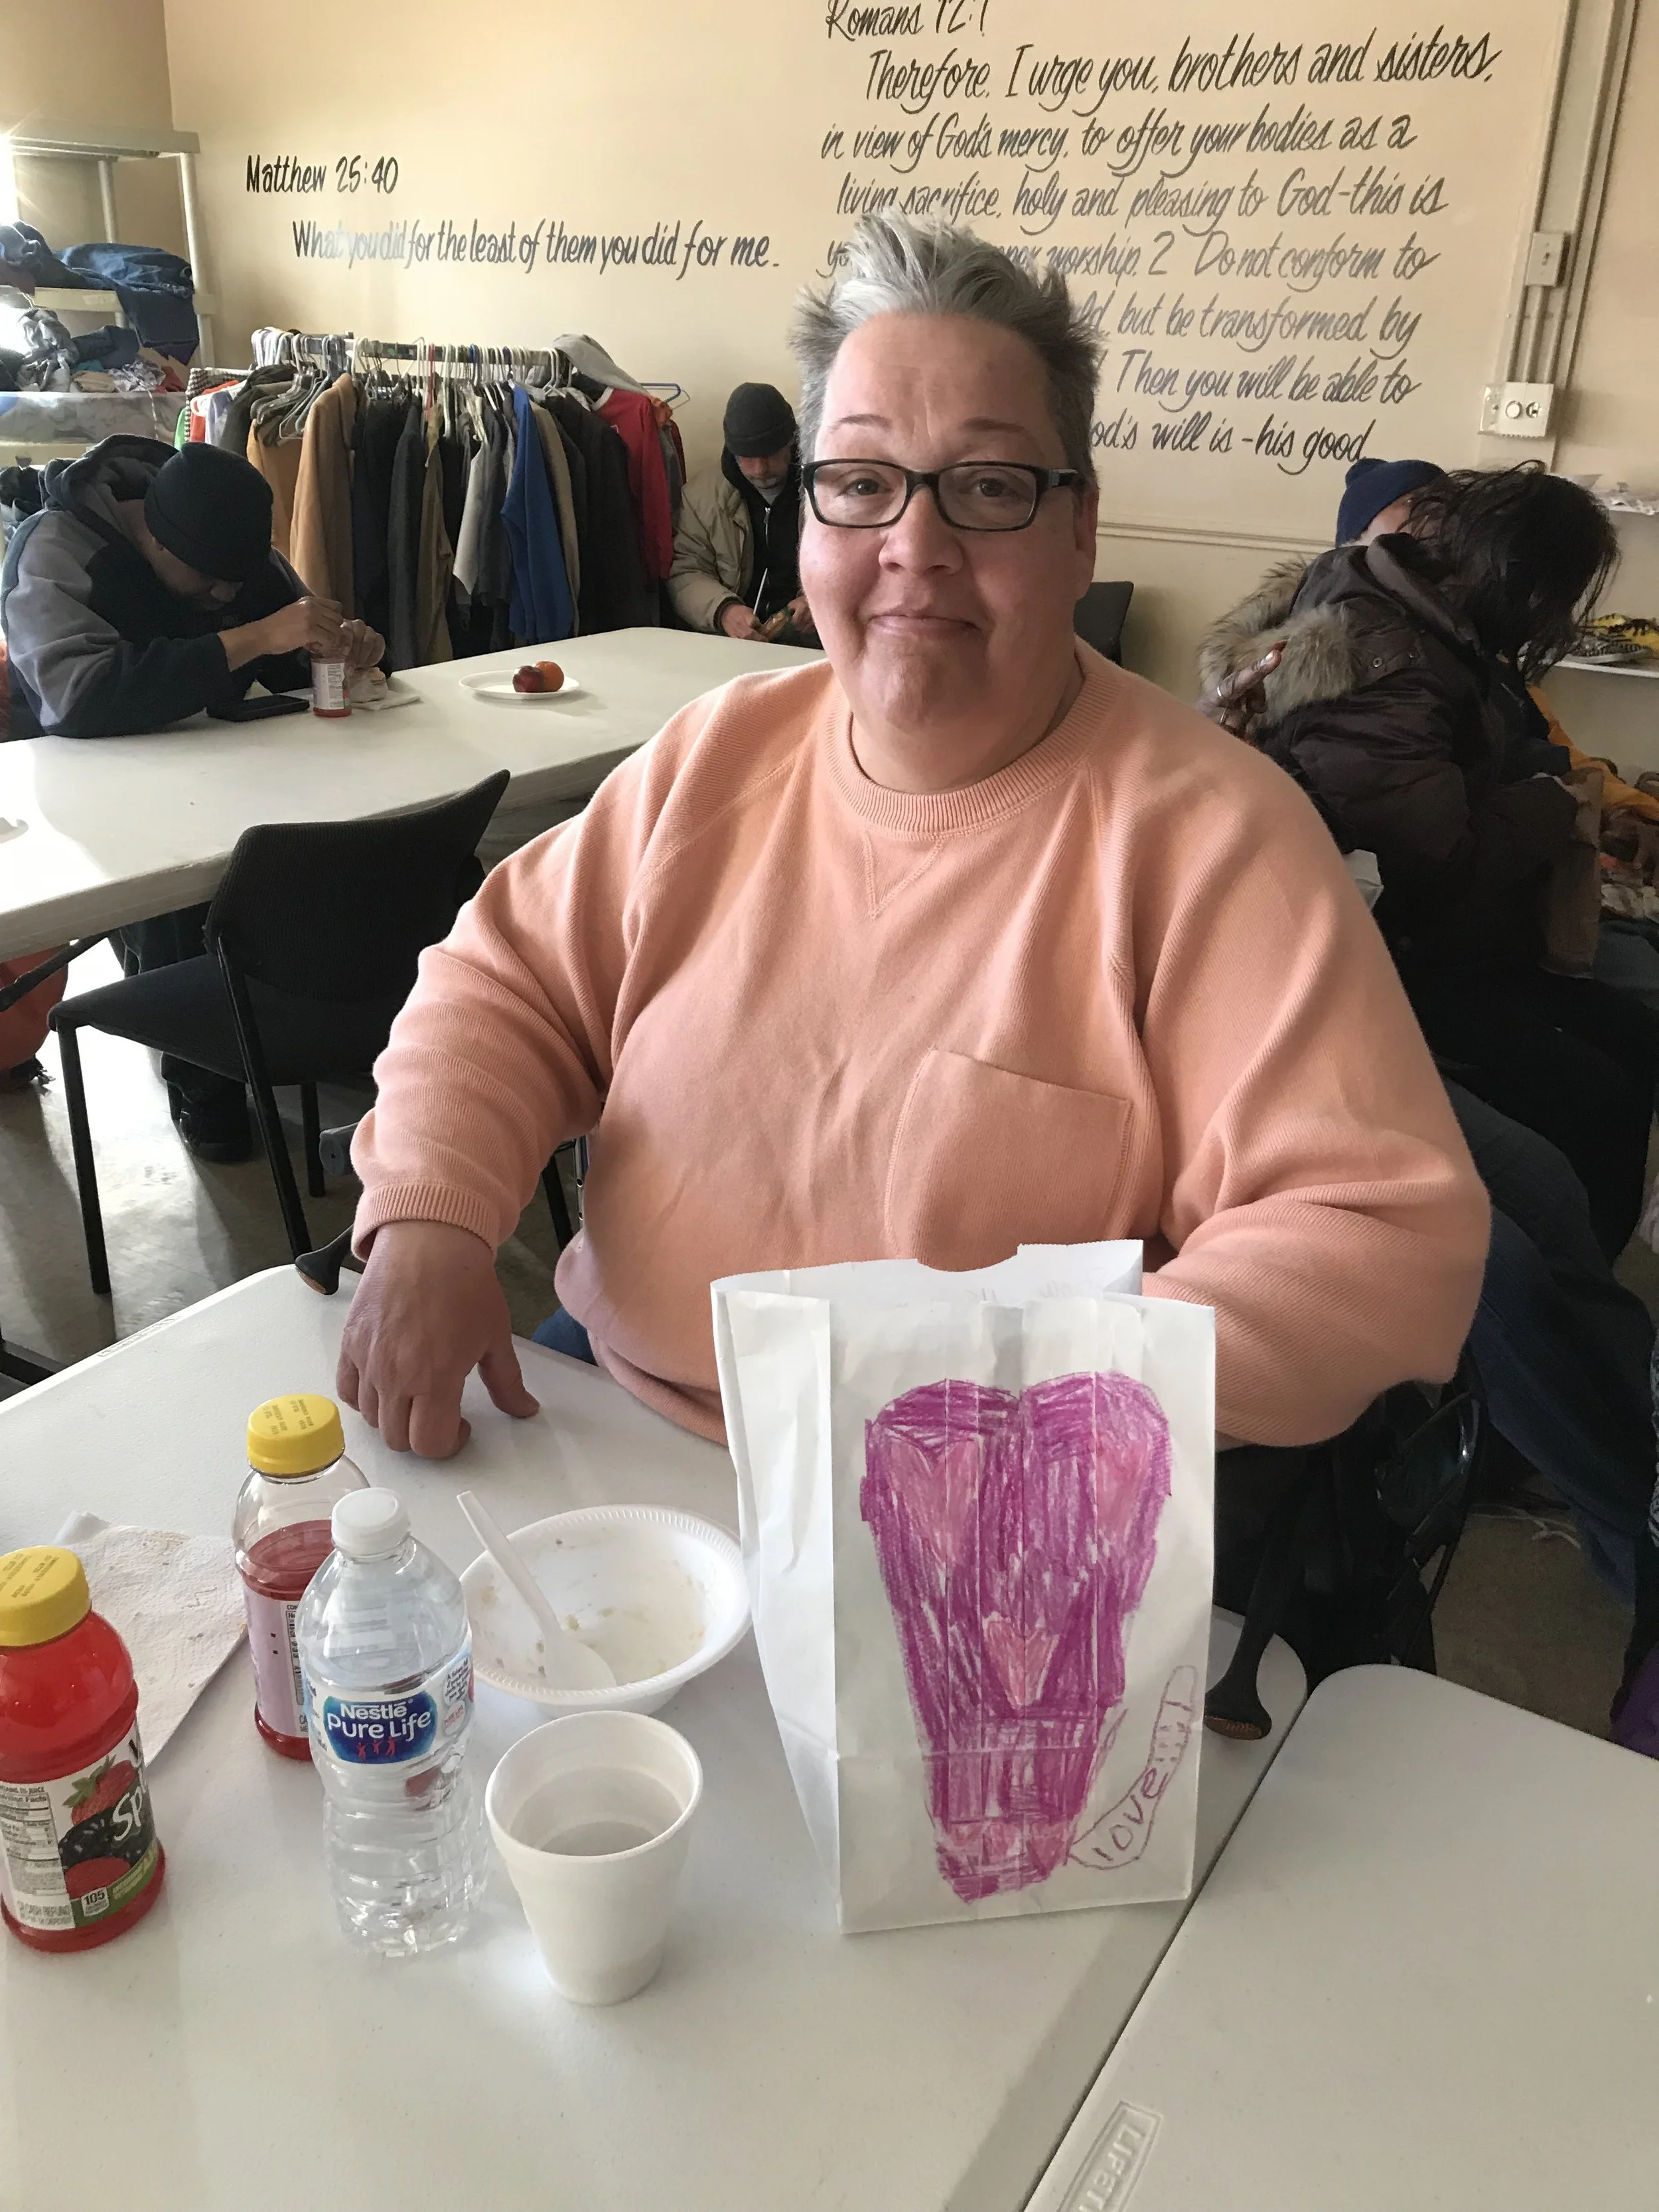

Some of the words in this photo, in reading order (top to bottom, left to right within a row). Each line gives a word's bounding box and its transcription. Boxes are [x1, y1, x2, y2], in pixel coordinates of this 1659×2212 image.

[826, 0, 924, 42] Romans
[1005, 43, 1034, 98] I
[1028, 54, 1094, 112] urge
[1168, 32, 1303, 92] brothers
[1307, 27, 1377, 84] and
[821, 123, 845, 159] in
[853, 124, 906, 159] view
[890, 112, 940, 174] of
[936, 112, 993, 159] God's
[1082, 117, 1115, 156] to
[1106, 108, 1185, 178] offer
[1159, 121, 1251, 179] your
[1246, 102, 1334, 153] bodies
[1338, 114, 1384, 151] as
[1387, 113, 1418, 149] a
[246, 154, 327, 193] Matthew
[335, 155, 399, 194] 25:40
[1012, 170, 1068, 236] holy
[1072, 177, 1125, 217] and
[1124, 177, 1236, 237] pleasing
[1237, 168, 1269, 217] to
[1407, 174, 1449, 216] is
[293, 219, 343, 258] What
[346, 230, 379, 269] you
[379, 220, 407, 260] did
[403, 219, 436, 269] for
[437, 219, 467, 261] the
[469, 218, 516, 263] least
[518, 218, 546, 274] of
[546, 220, 597, 265] them
[599, 235, 640, 275] you
[641, 220, 681, 266] did
[676, 219, 729, 281] for
[730, 234, 779, 267] me.
[1147, 230, 1175, 275] 2
[1194, 230, 1236, 277] Do
[1236, 231, 1283, 279] not
[1277, 232, 1386, 293] conform
[1392, 230, 1442, 280] to
[1118, 290, 1166, 336] but
[1165, 292, 1195, 338] be
[1199, 293, 1378, 353] transformed
[1369, 294, 1423, 360] by
[1116, 348, 1180, 396] Then
[1158, 368, 1234, 413] you
[1236, 354, 1298, 400] will
[1288, 355, 1321, 402] be
[1323, 356, 1378, 402] able
[1380, 358, 1422, 404] to
[1091, 407, 1139, 450] od's
[1151, 410, 1212, 451] will
[1208, 417, 1234, 453] is
[1277, 418, 1376, 475] good
[327, 1712, 385, 1738] Pure
[390, 1710, 431, 1742] Life
[84, 1891, 106, 1905] 105
